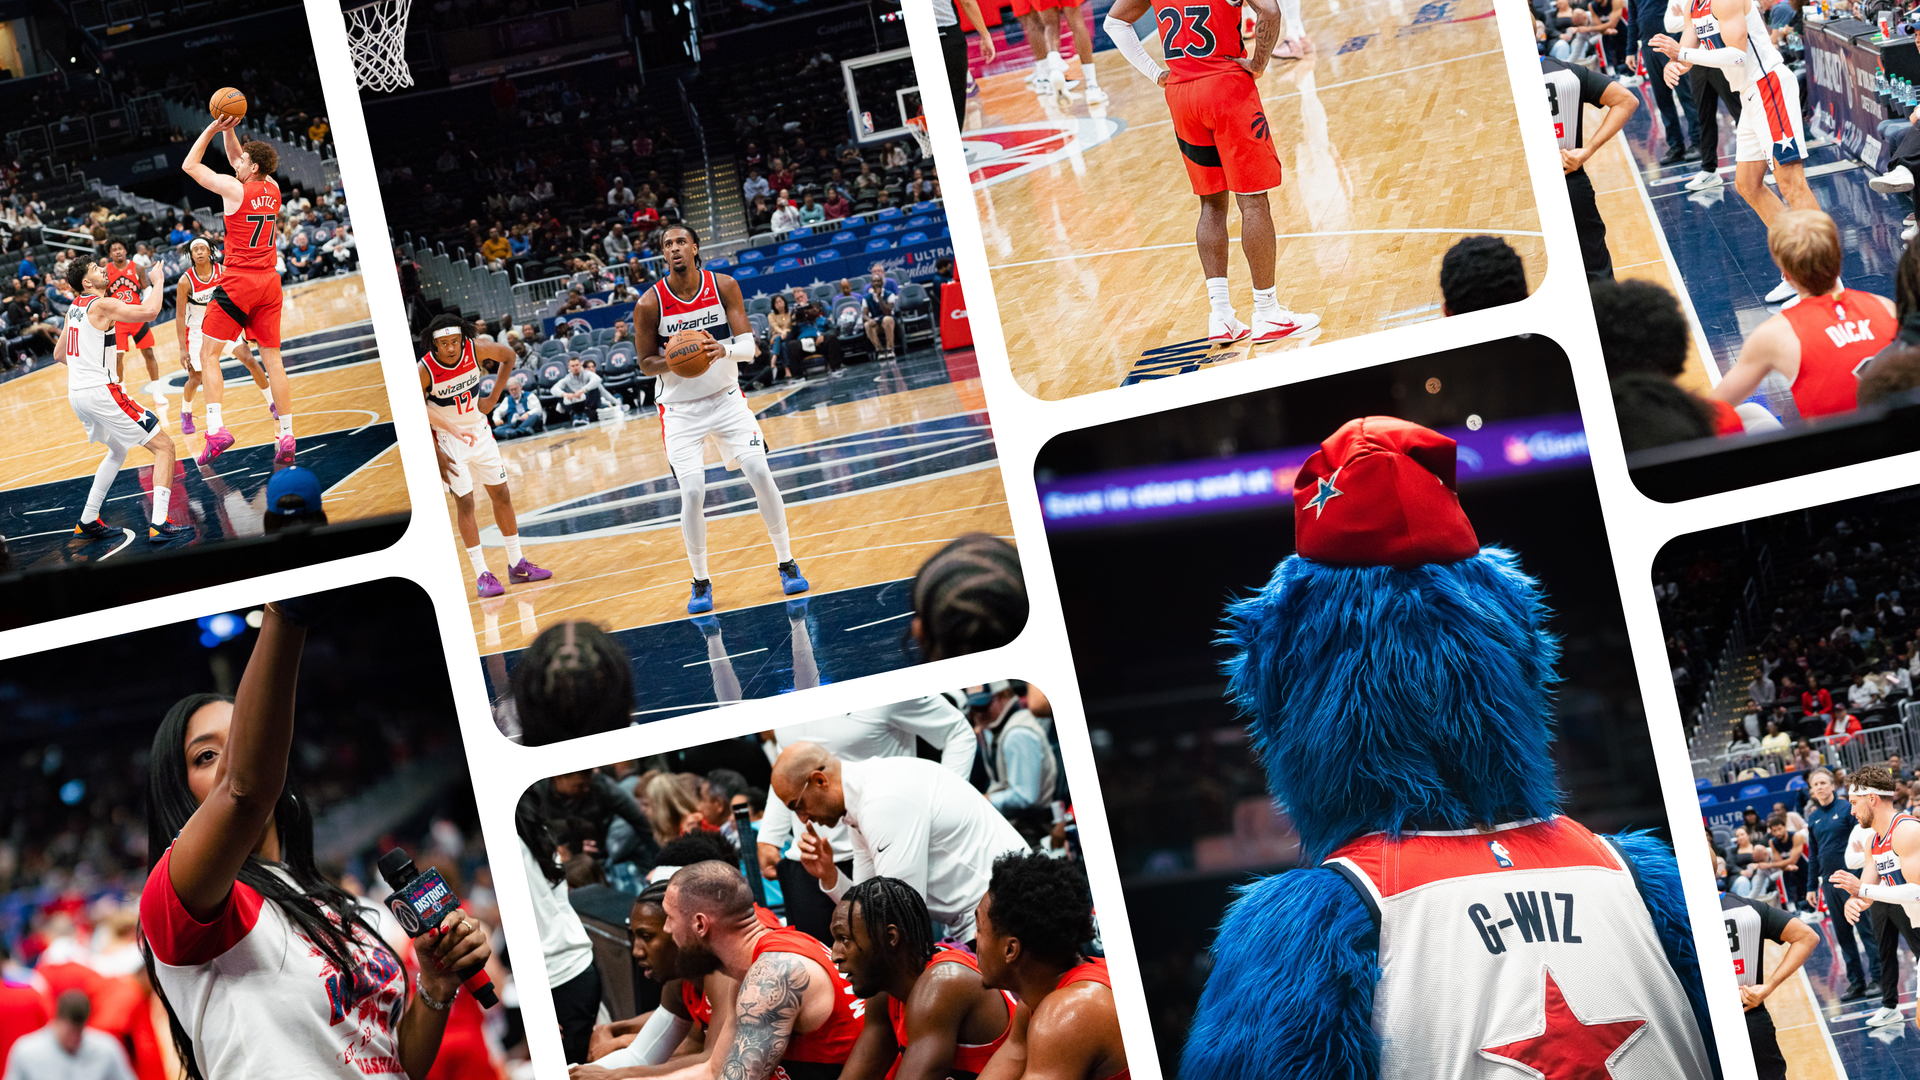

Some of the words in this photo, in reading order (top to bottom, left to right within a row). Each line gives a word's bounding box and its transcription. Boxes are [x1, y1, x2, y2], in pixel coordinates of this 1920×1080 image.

[1157, 5, 1216, 60] 23
[250, 195, 278, 210] BATTLE
[246, 213, 276, 249] 77
[914, 246, 953, 262] ULTRA
[666, 311, 718, 333] wizards
[1825, 318, 1875, 348] DICK
[67, 327, 79, 357] 00
[668, 342, 700, 360] Wilson
[437, 374, 477, 396] wizards
[453, 390, 474, 415] 12
[413, 889, 425, 899] For
[423, 879, 437, 891] The
[414, 882, 448, 913] DISTRICT
[1468, 890, 1583, 955] G-WIZ
